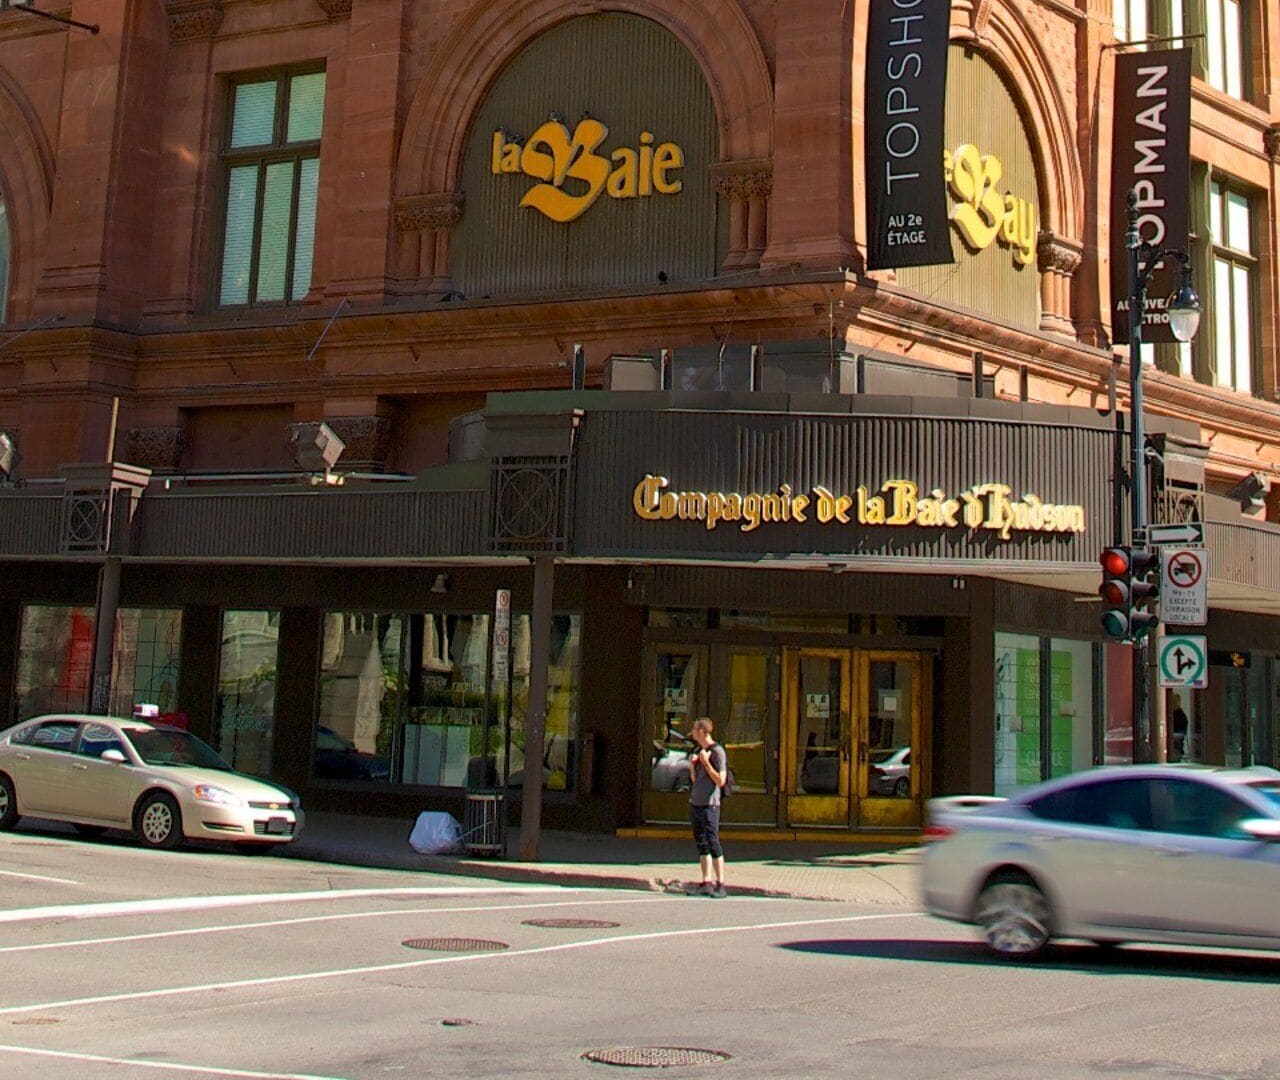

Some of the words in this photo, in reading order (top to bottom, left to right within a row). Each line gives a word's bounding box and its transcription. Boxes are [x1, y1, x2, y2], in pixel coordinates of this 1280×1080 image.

[491, 130, 523, 175] la
[519, 117, 685, 223] Baie
[888, 214, 905, 229] AU
[907, 213, 923, 227] 2e
[948, 143, 1035, 265] Bay
[887, 230, 927, 246] ÉTAGE
[632, 473, 809, 532] Compagnie
[812, 485, 851, 524] de
[856, 485, 886, 526] la
[880, 479, 960, 528] Baie
